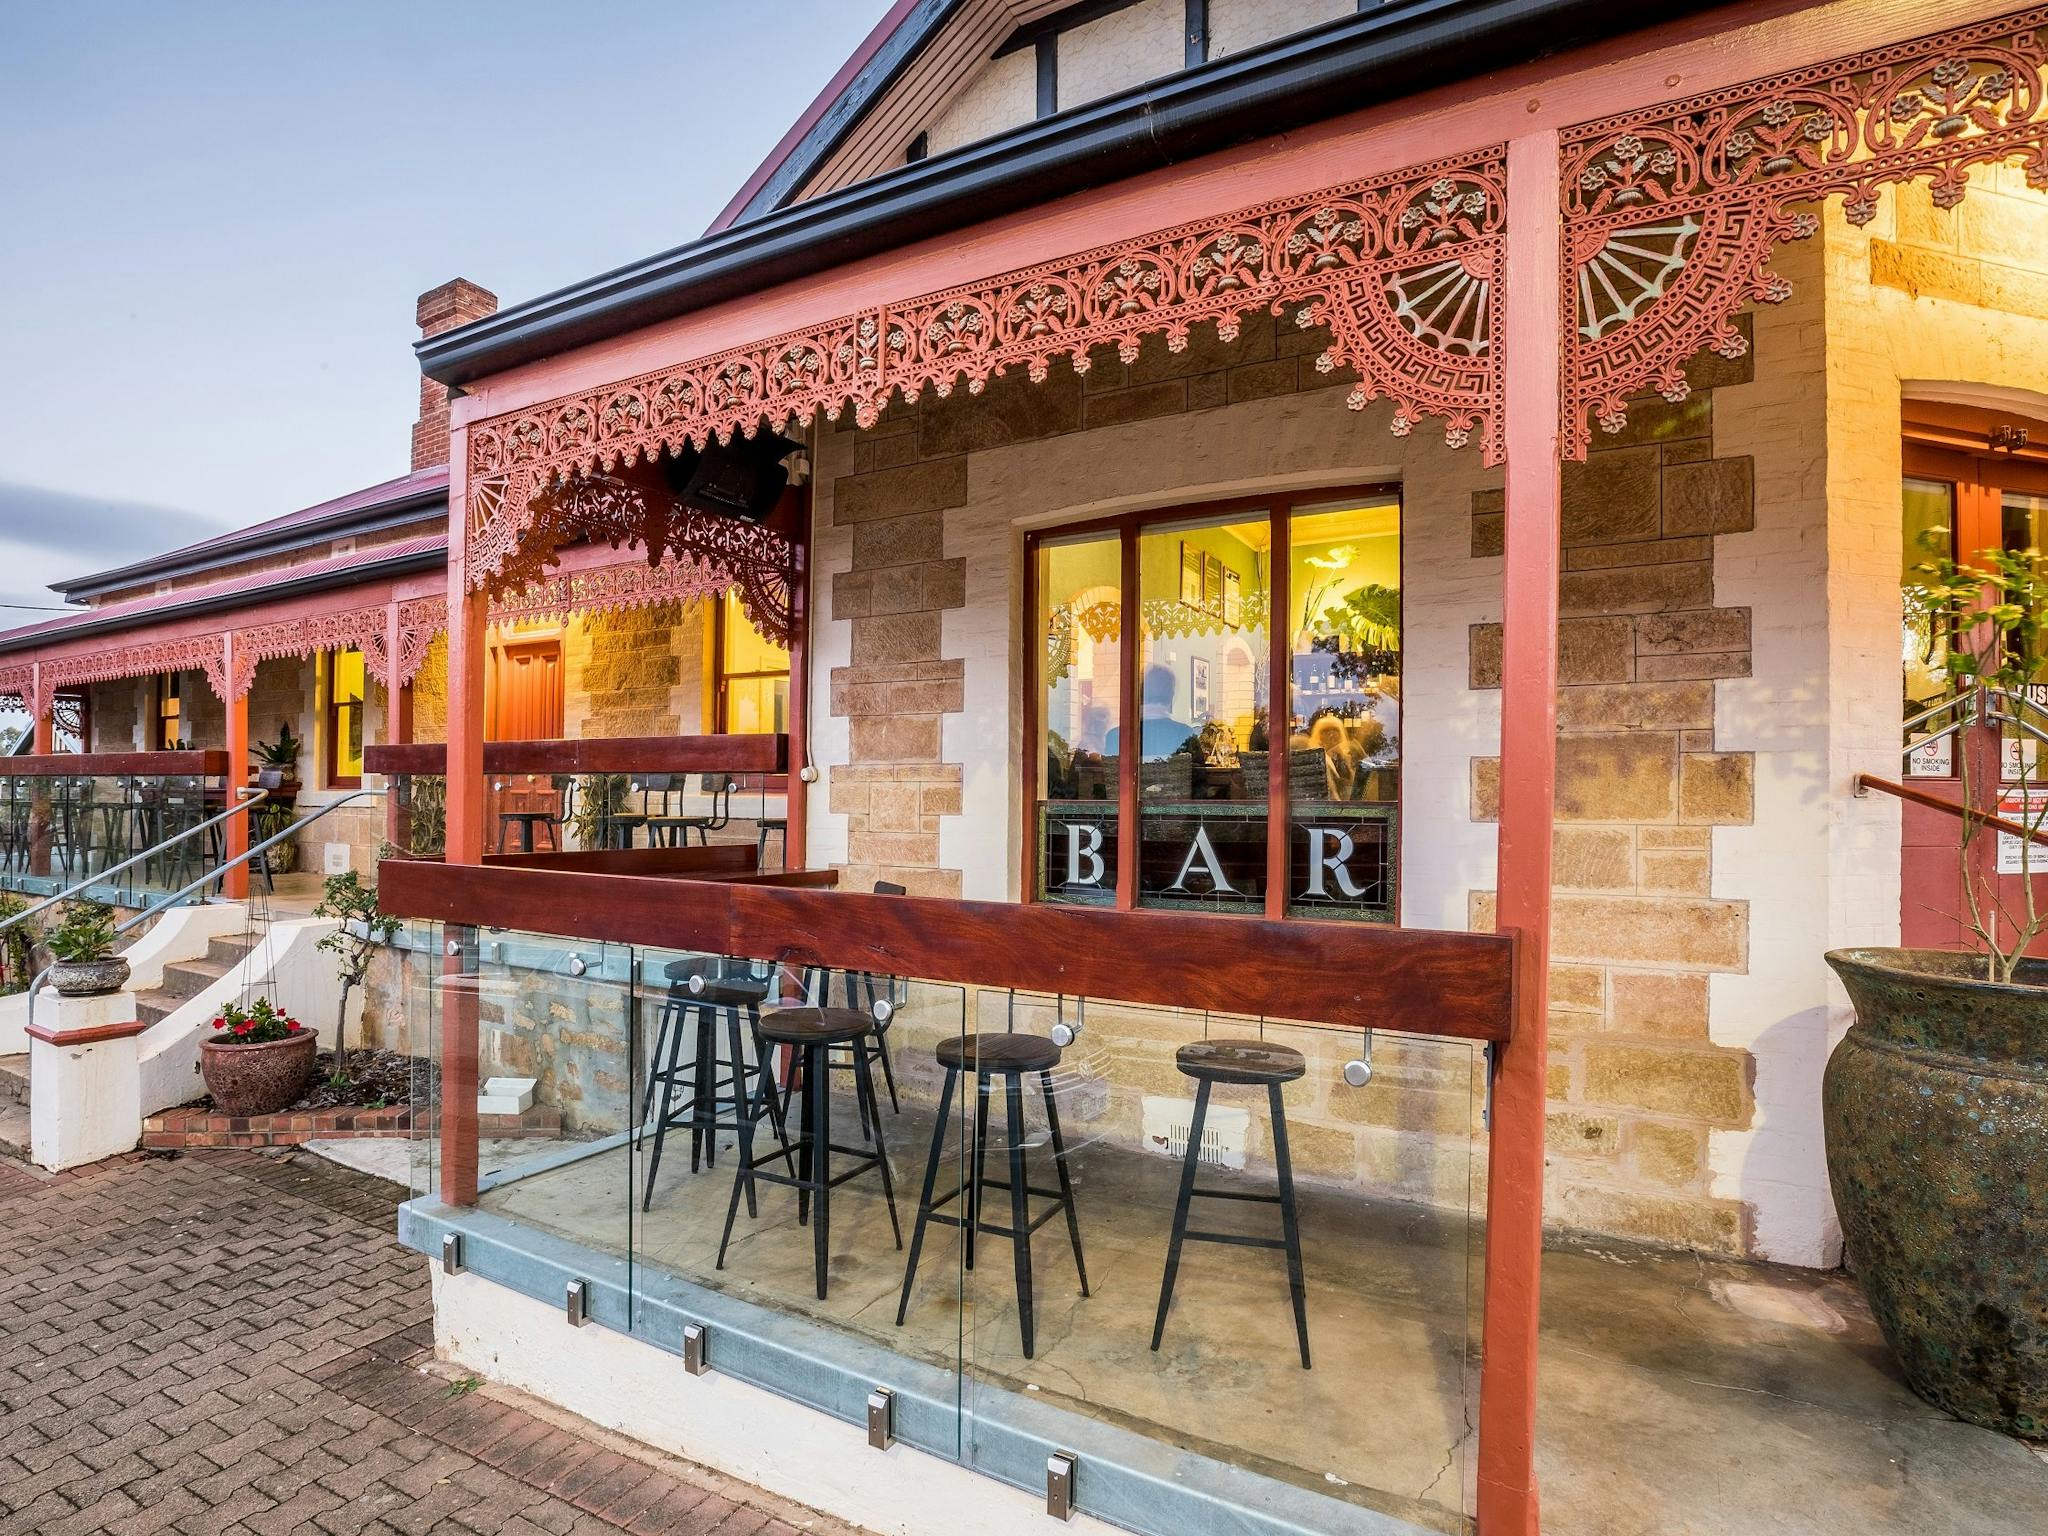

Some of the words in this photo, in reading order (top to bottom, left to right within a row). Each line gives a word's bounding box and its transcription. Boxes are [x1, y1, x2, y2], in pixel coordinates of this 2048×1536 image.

[1912, 757, 1921, 765] NO
[1922, 758, 1950, 766] SMOKING
[1066, 824, 1367, 898] BAR
